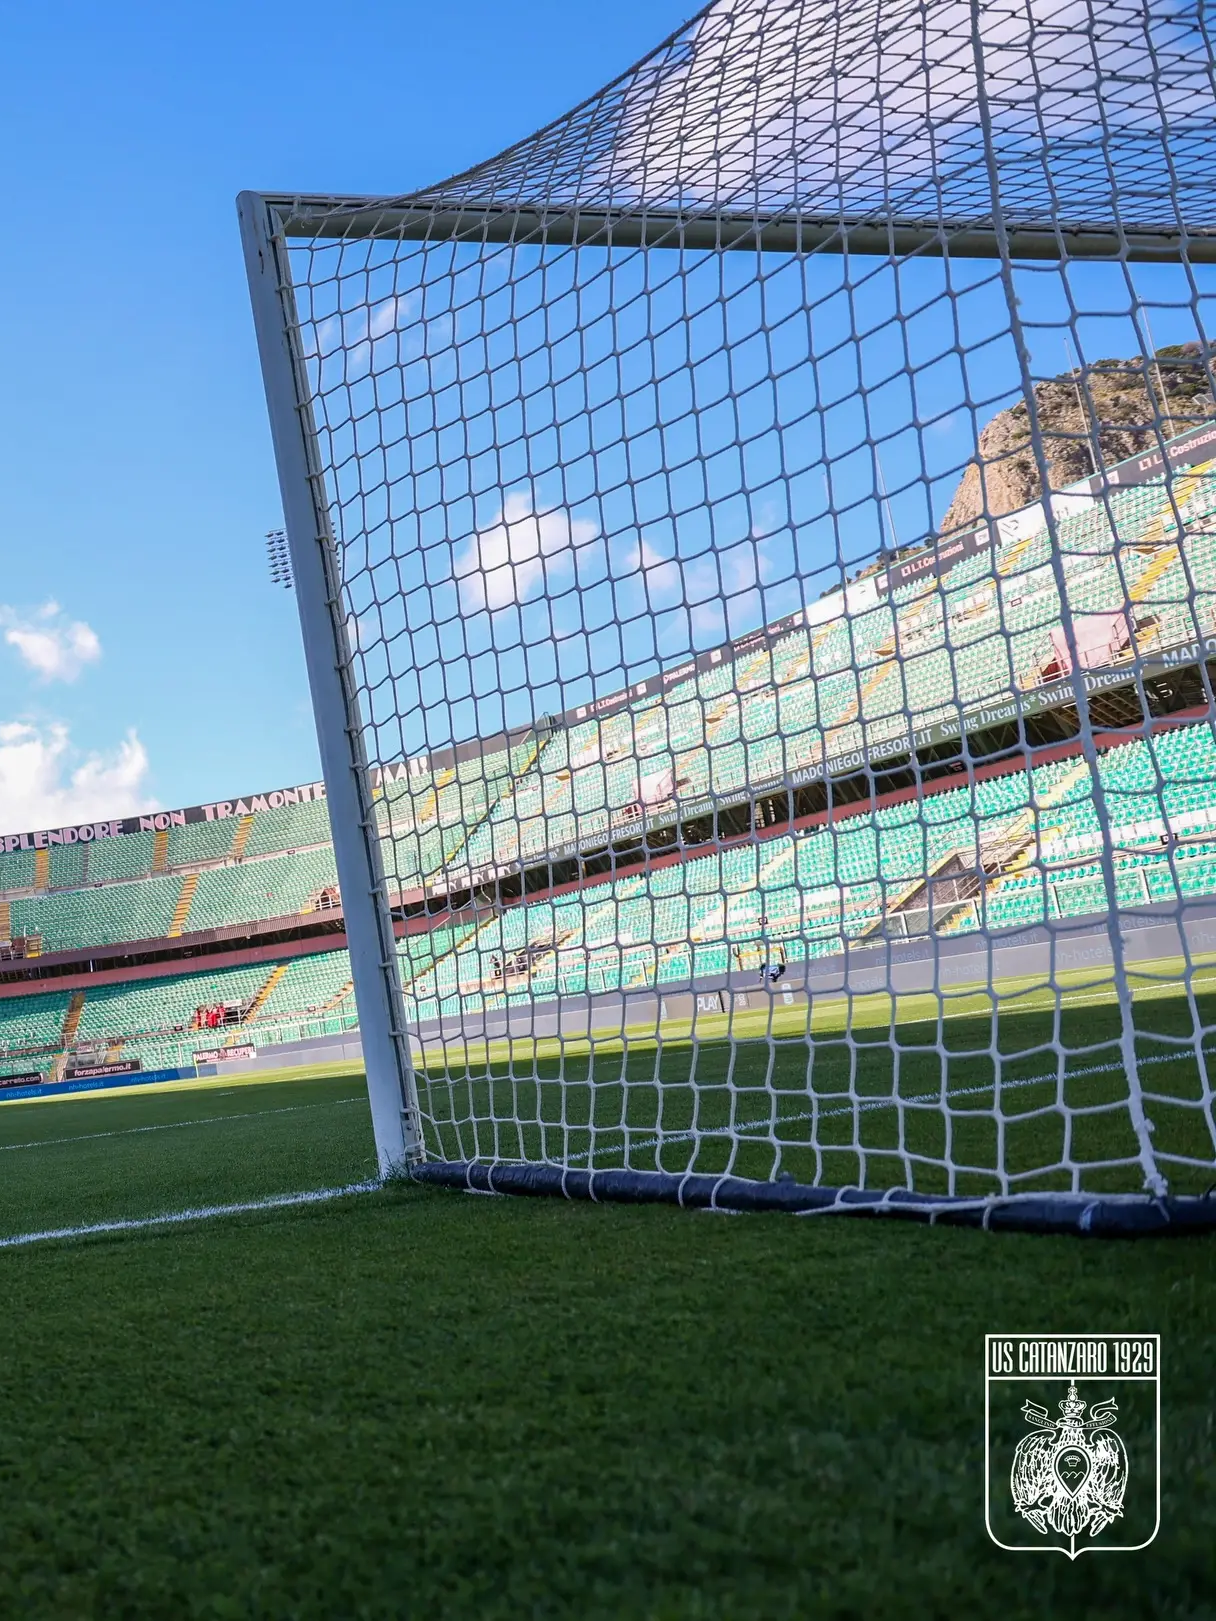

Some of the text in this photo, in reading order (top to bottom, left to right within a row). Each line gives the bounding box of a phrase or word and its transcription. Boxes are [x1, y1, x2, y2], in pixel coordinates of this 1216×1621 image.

[1038, 685, 1076, 706] Swin
[139, 809, 186, 831] NON
[202, 781, 326, 822] TRAMONTE
[74, 1063, 132, 1077] forzapalermo.it
